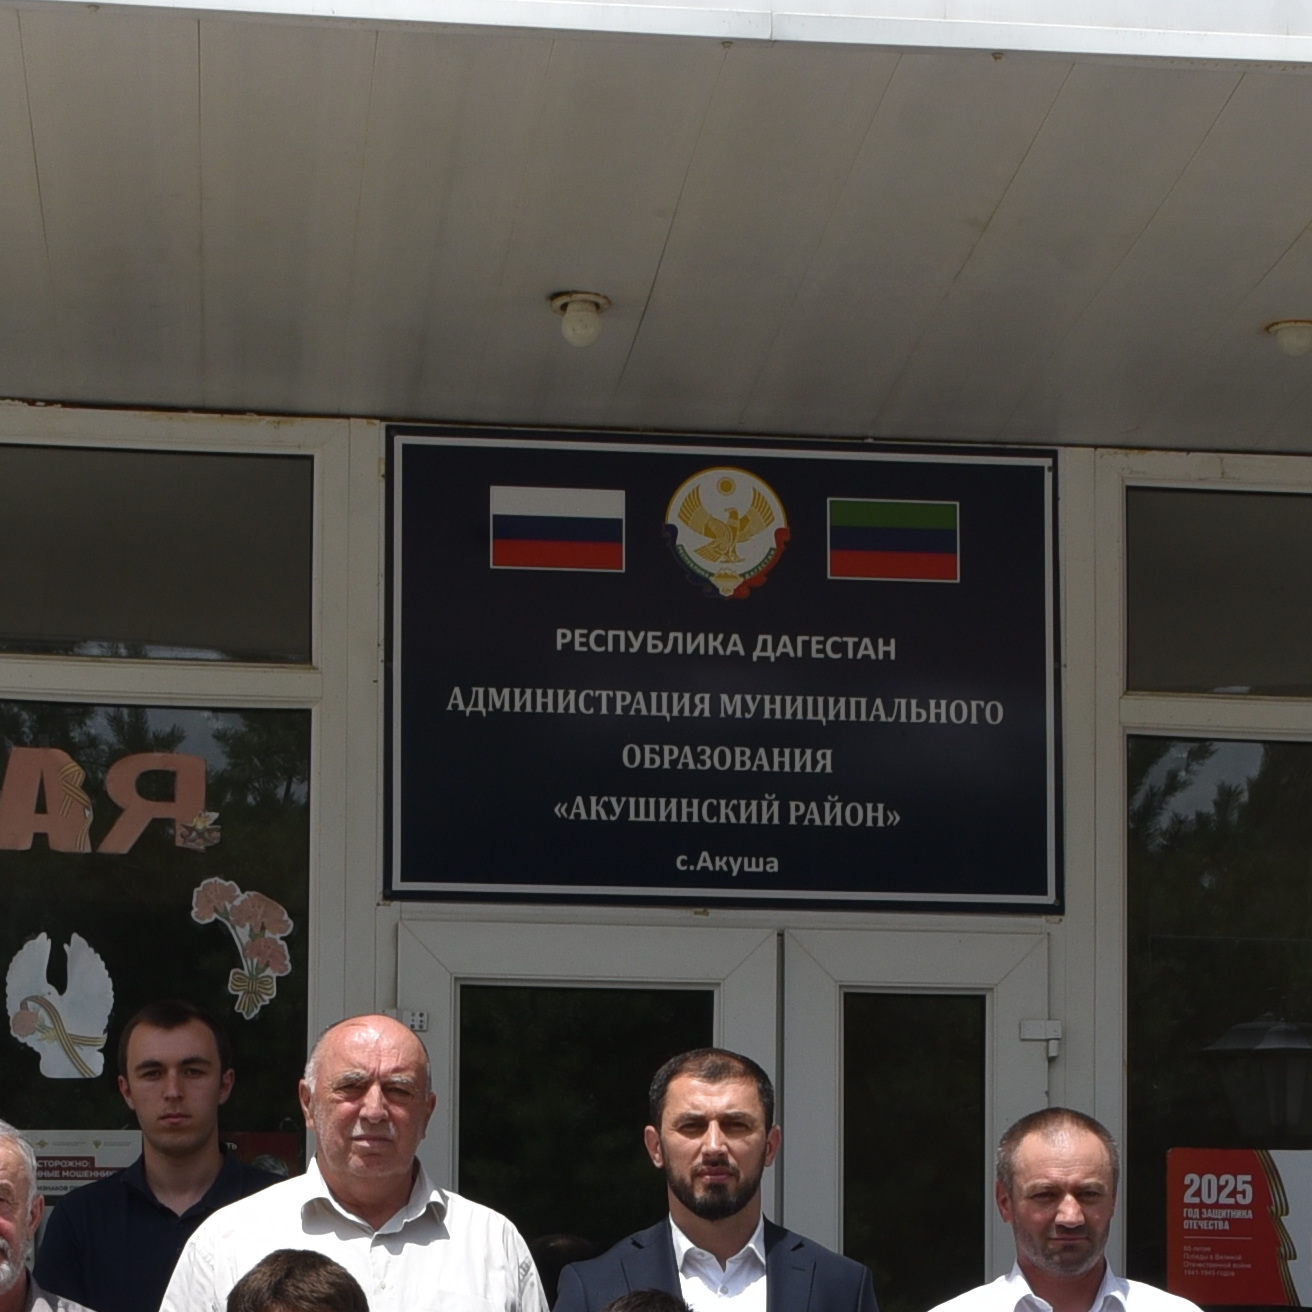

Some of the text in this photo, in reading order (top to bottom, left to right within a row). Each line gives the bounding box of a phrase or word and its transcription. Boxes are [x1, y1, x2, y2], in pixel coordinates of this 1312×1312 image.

[555, 628, 896, 662] РЕСПУБЛИКА ДАГЕСТАН
[446, 686, 1004, 726] АДМИНИСТРАЦИЯ МУНИЦИПАЛЬНОГО
[622, 744, 833, 773] ОБРАЗОВАНИЯ
[554, 793, 901, 829] «АКУШИНСКИЙ РАЙОН»
[675, 849, 779, 876] с.Акуша
[37, 1160, 91, 1168] СТОРОЖНО:
[1183, 1173, 1253, 1205] 2025
[1183, 1208, 1253, 1220] ГОД ЗАЩИТНИКА
[1183, 1220, 1230, 1230] ОТЕЧЕСТВА
